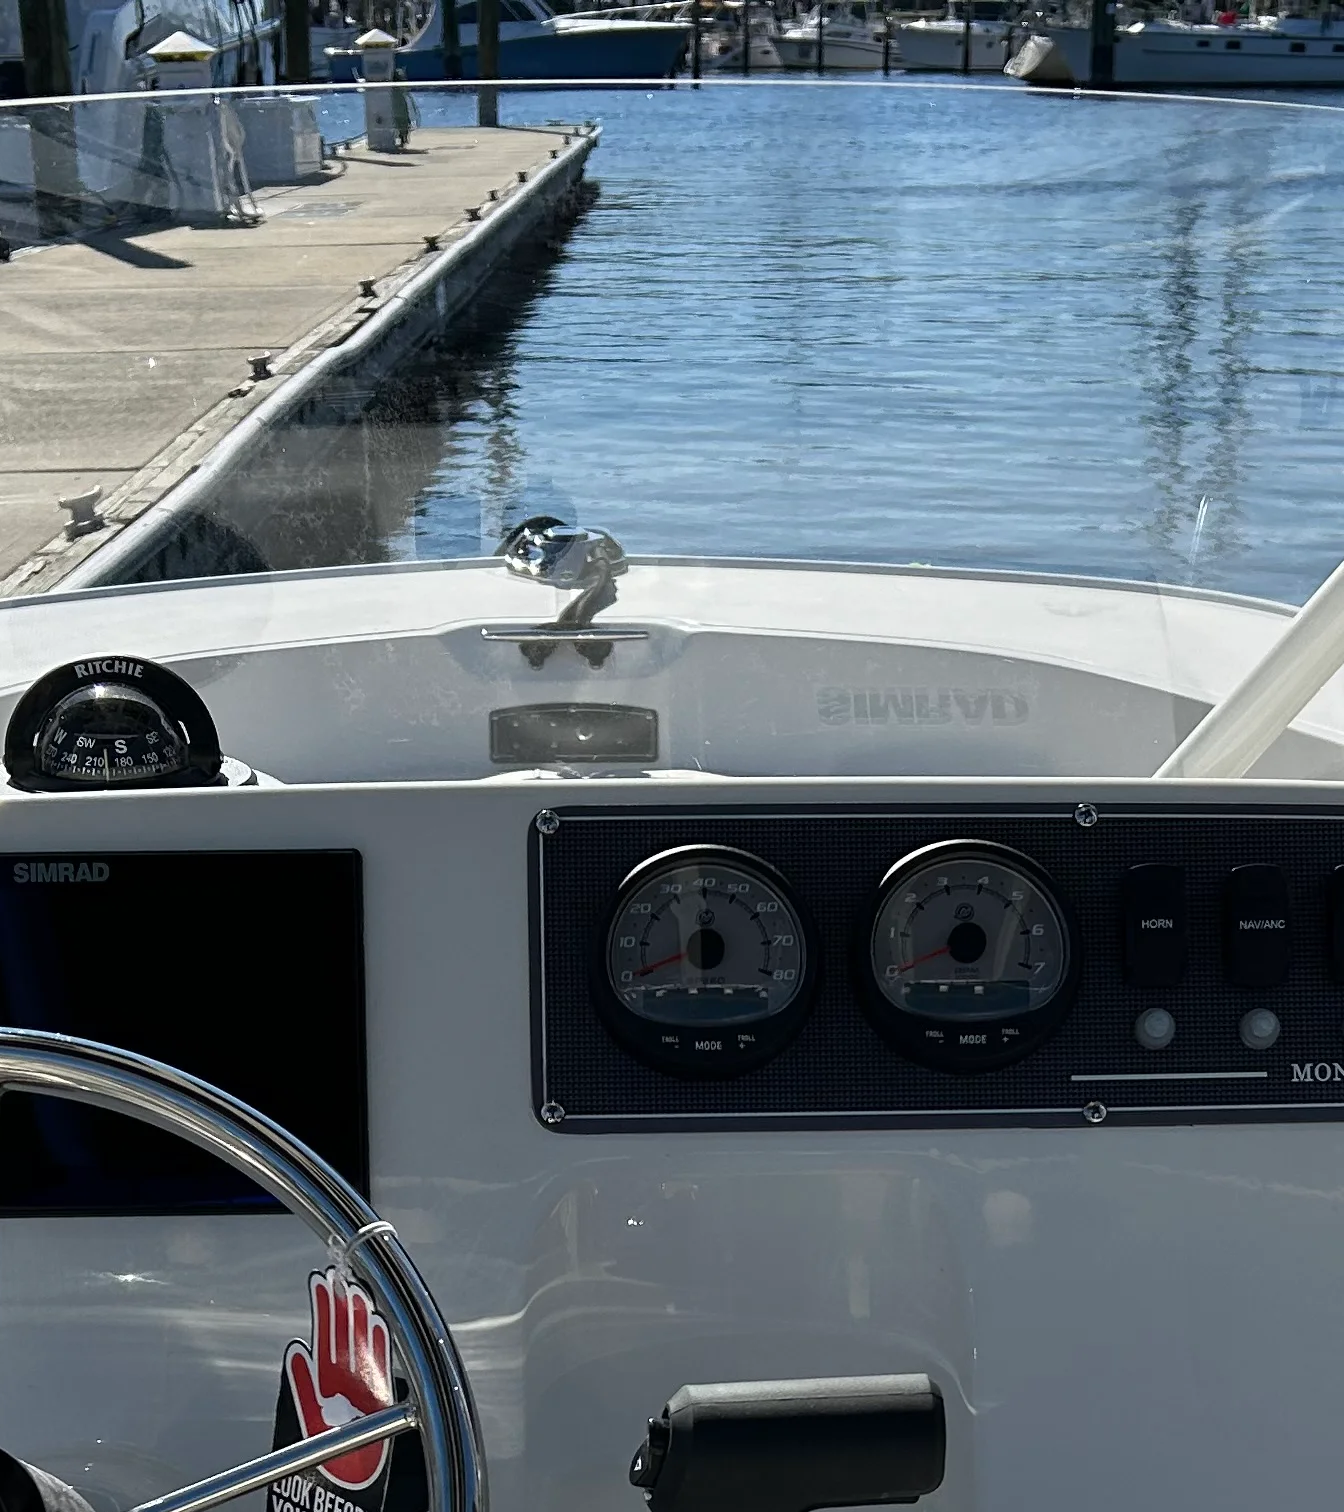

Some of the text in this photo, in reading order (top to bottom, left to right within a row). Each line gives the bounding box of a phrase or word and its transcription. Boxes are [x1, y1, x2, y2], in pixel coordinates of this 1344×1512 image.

[74, 661, 144, 678] RITCHIE
[76, 737, 96, 748] SW
[115, 740, 127, 754] S
[86, 757, 104, 767] 210
[115, 757, 133, 766] 180
[142, 753, 158, 764] 150
[14, 863, 109, 883] SIMRAD
[693, 878, 715, 887] 40
[937, 877, 948, 885] 3
[660, 884, 682, 894] 30
[727, 884, 749, 893] 50
[905, 893, 916, 902] 2
[1012, 891, 1024, 900] 5
[630, 903, 651, 913] 20
[757, 902, 778, 912] 60
[1142, 919, 1173, 929] HORN
[1239, 920, 1285, 929] NAV/ANC
[890, 927, 894, 938] 1
[1032, 925, 1044, 935] 6
[620, 937, 635, 948] 10
[773, 935, 793, 946] 70
[1035, 962, 1045, 974] 7
[621, 971, 633, 982] 0
[773, 970, 795, 980] 80
[960, 1035, 987, 1044] MODE
[696, 1042, 722, 1050] MODE
